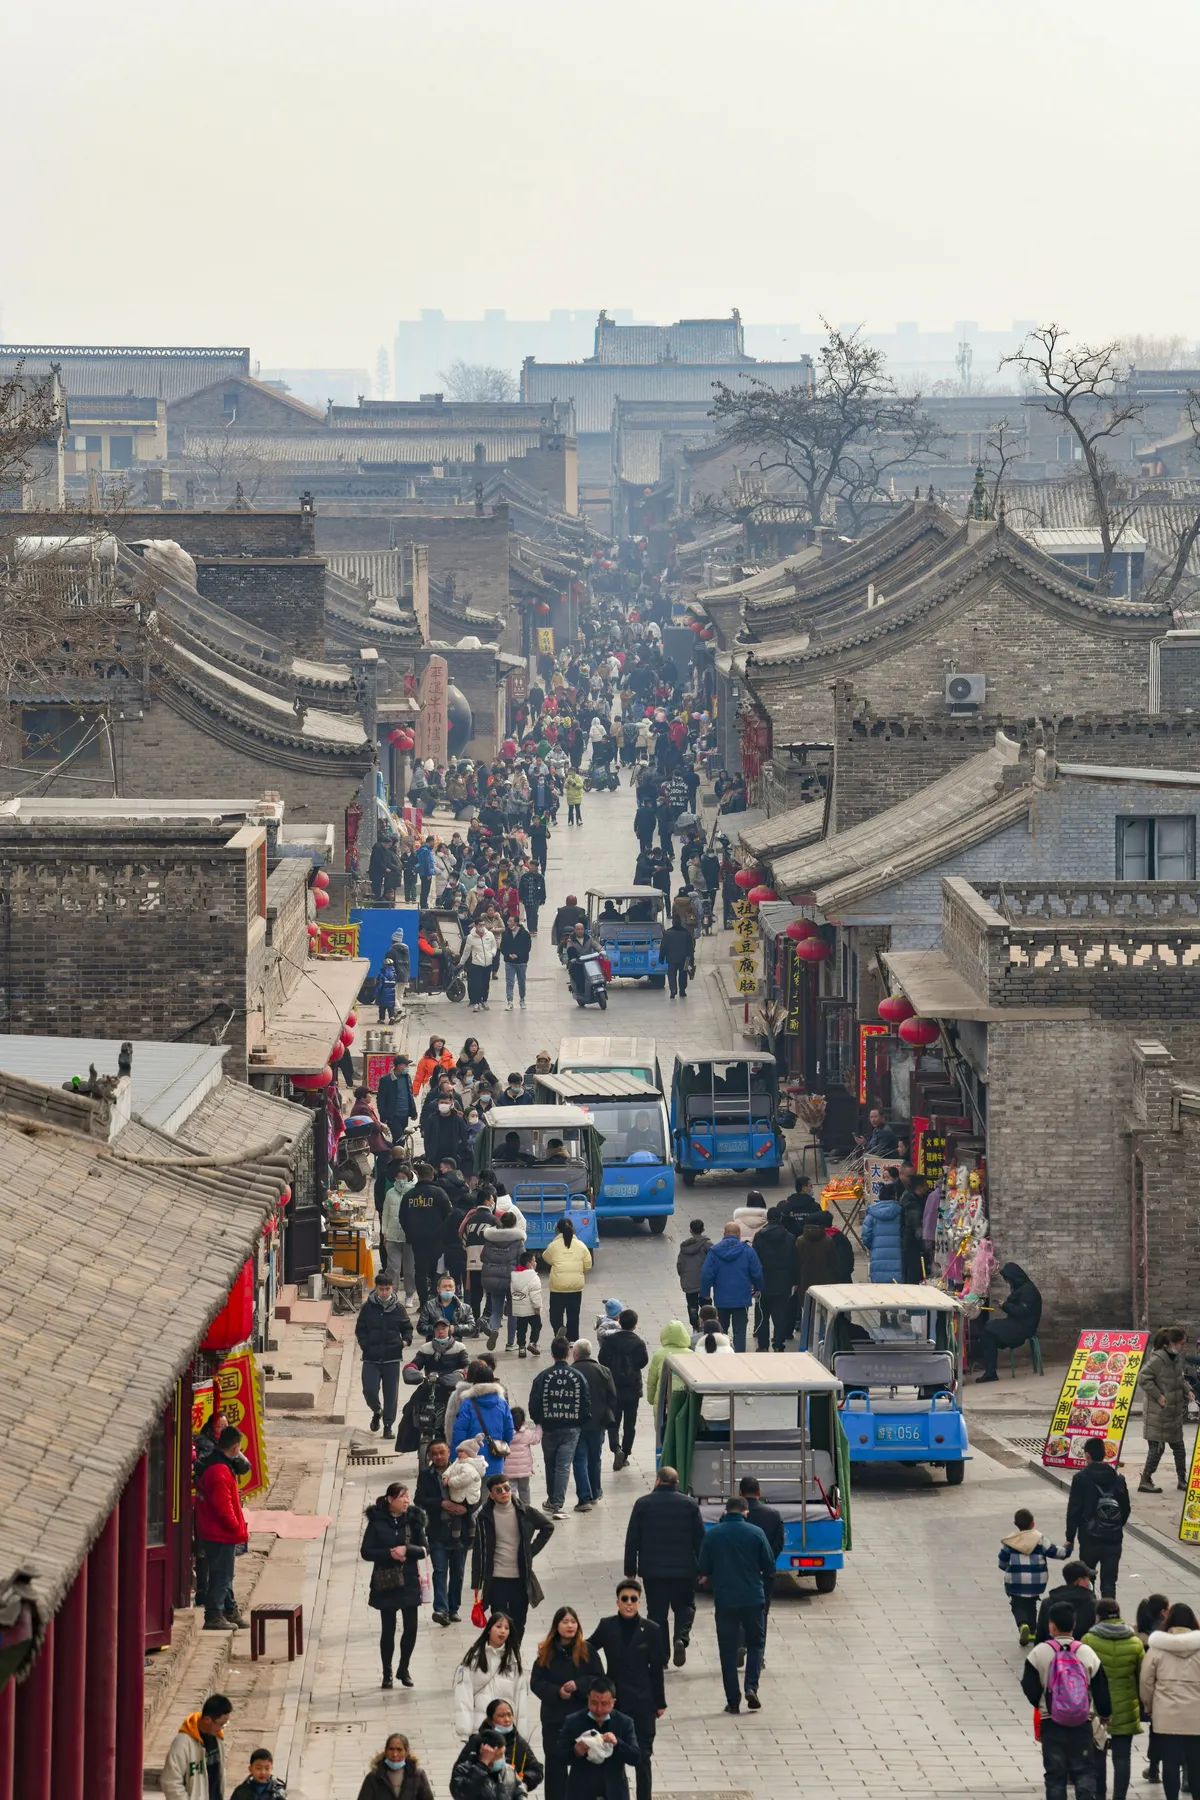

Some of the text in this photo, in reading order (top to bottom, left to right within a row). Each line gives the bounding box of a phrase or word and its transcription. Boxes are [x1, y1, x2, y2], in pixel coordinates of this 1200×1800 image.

[737, 905, 756, 992] 祖传豆腐脑
[409, 1197, 433, 1208] POLO
[1083, 1333, 1141, 1350] 特色小吃
[1053, 1351, 1088, 1432] 手工刀削面
[1111, 1354, 1141, 1430] 炒菜 米饭
